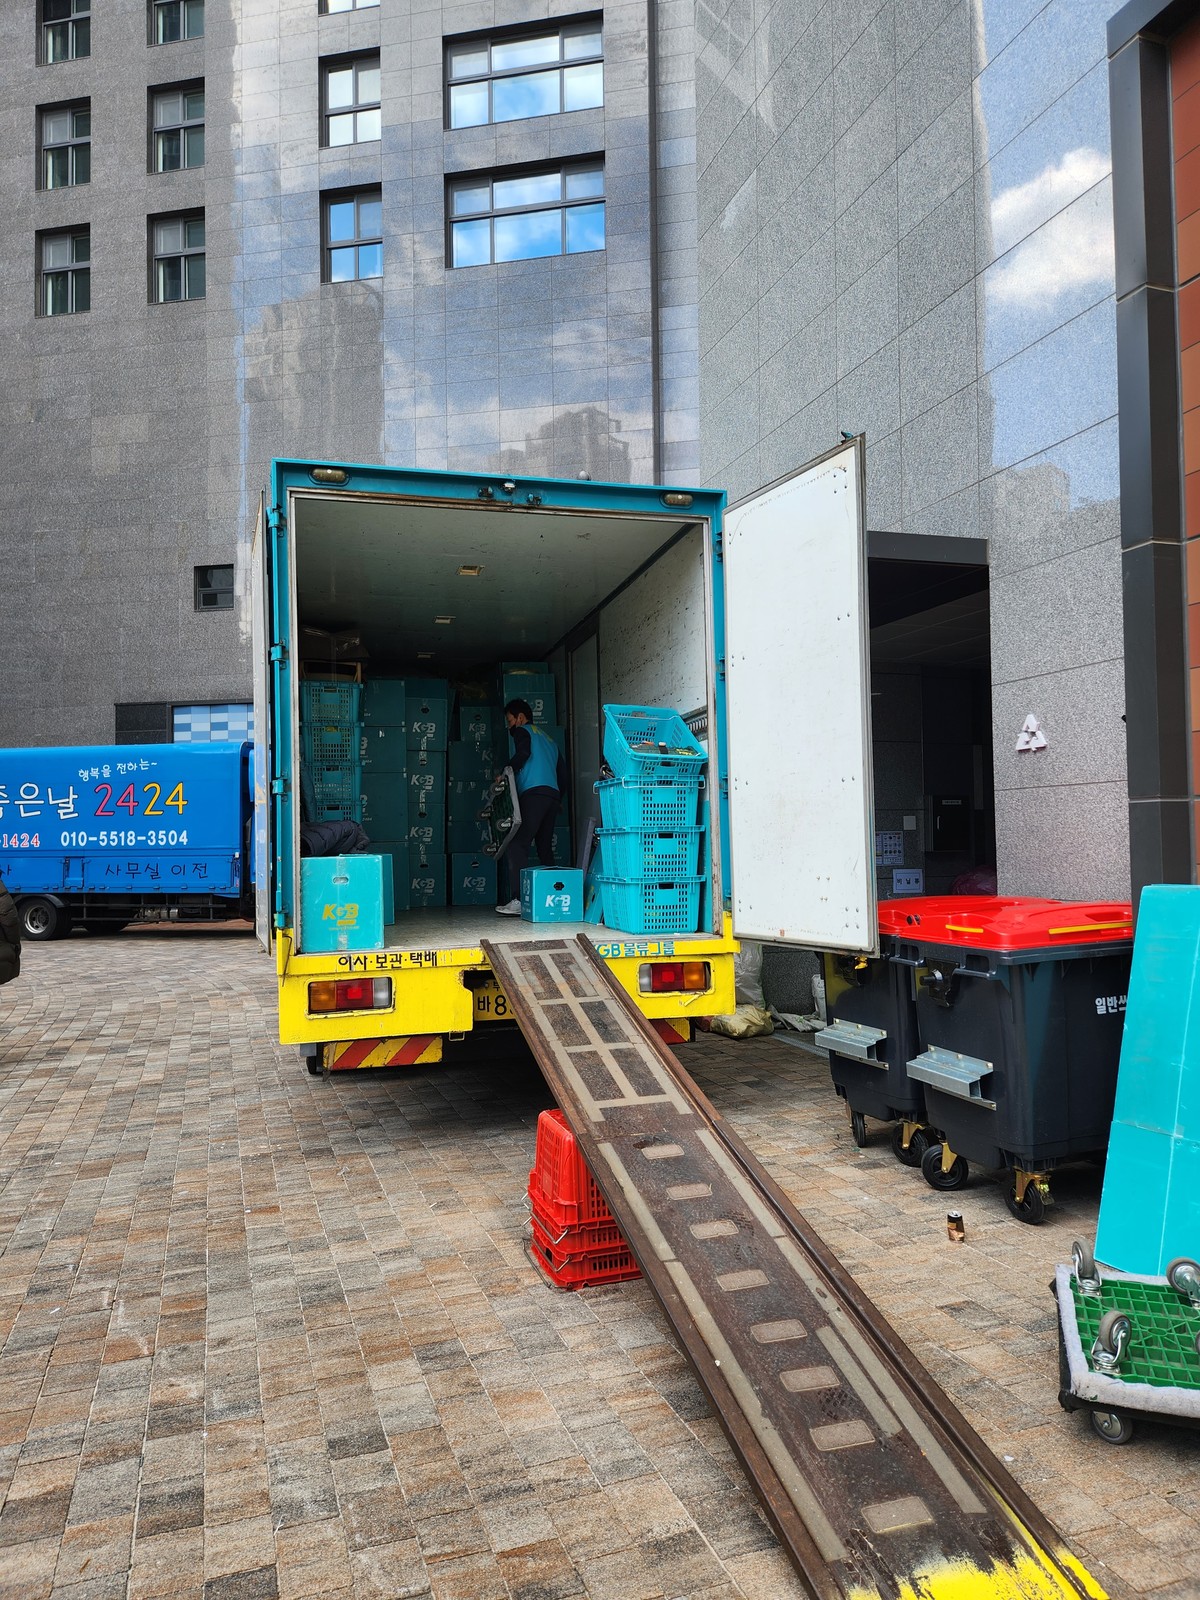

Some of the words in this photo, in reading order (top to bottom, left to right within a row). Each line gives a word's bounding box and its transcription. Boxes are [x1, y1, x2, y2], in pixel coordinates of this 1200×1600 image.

[78, 764, 112, 782] 행복을
[94, 781, 189, 817] 2424
[0, 833, 41, 848] 1424
[60, 830, 189, 847] 010-5518-3504
[105, 862, 162, 880] 사무실
[170, 862, 209, 879] 이전
[322, 903, 360, 920] KGB
[594, 943, 621, 958] GB
[624, 940, 674, 957] 물류그룹
